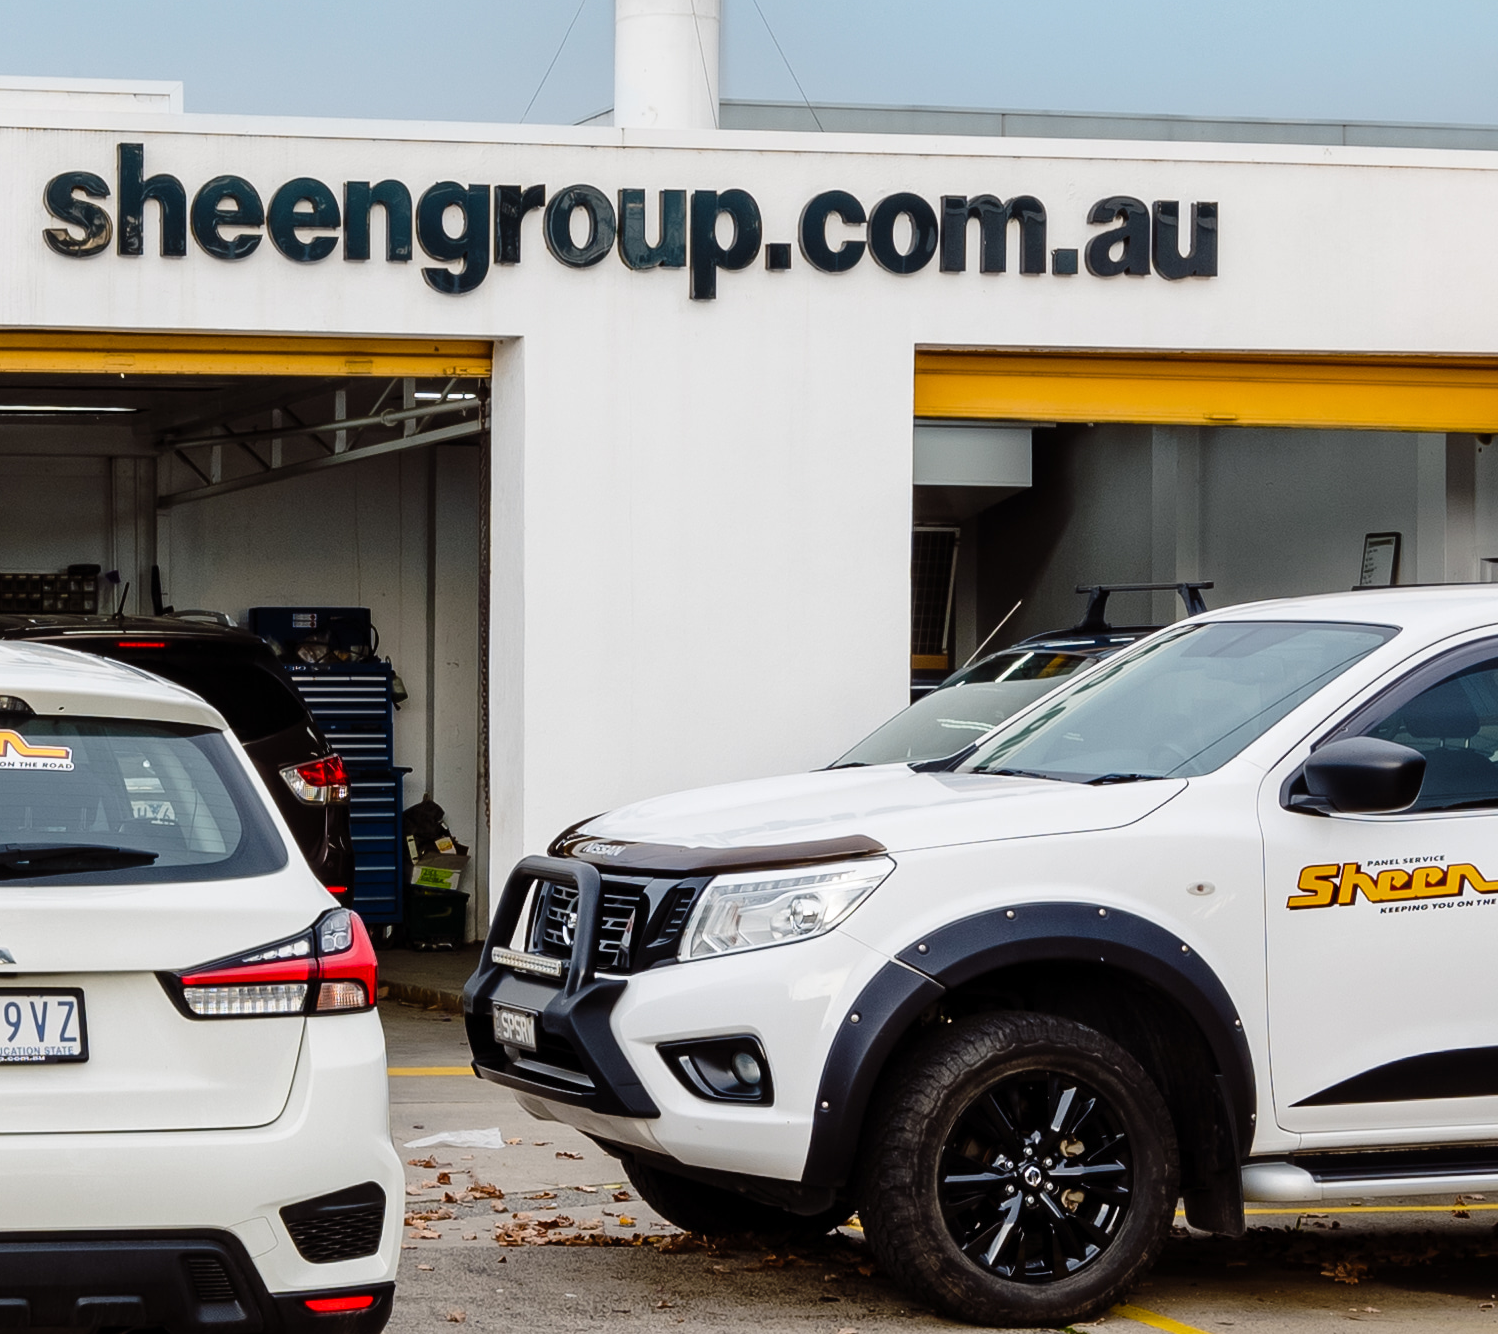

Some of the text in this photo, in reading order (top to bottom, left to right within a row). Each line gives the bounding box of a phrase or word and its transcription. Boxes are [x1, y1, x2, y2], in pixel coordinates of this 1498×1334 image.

[42, 142, 1219, 301] sheengroup.com.au
[1367, 855, 1446, 866] PANEL SERVICE
[1380, 904, 1429, 914] KEEPING
[1433, 901, 1455, 911] YOU
[1457, 900, 1475, 908] ON
[1476, 898, 1498, 906] THE
[4, 1001, 78, 1044] 9VZ
[44, 1046, 74, 1055] STATE
